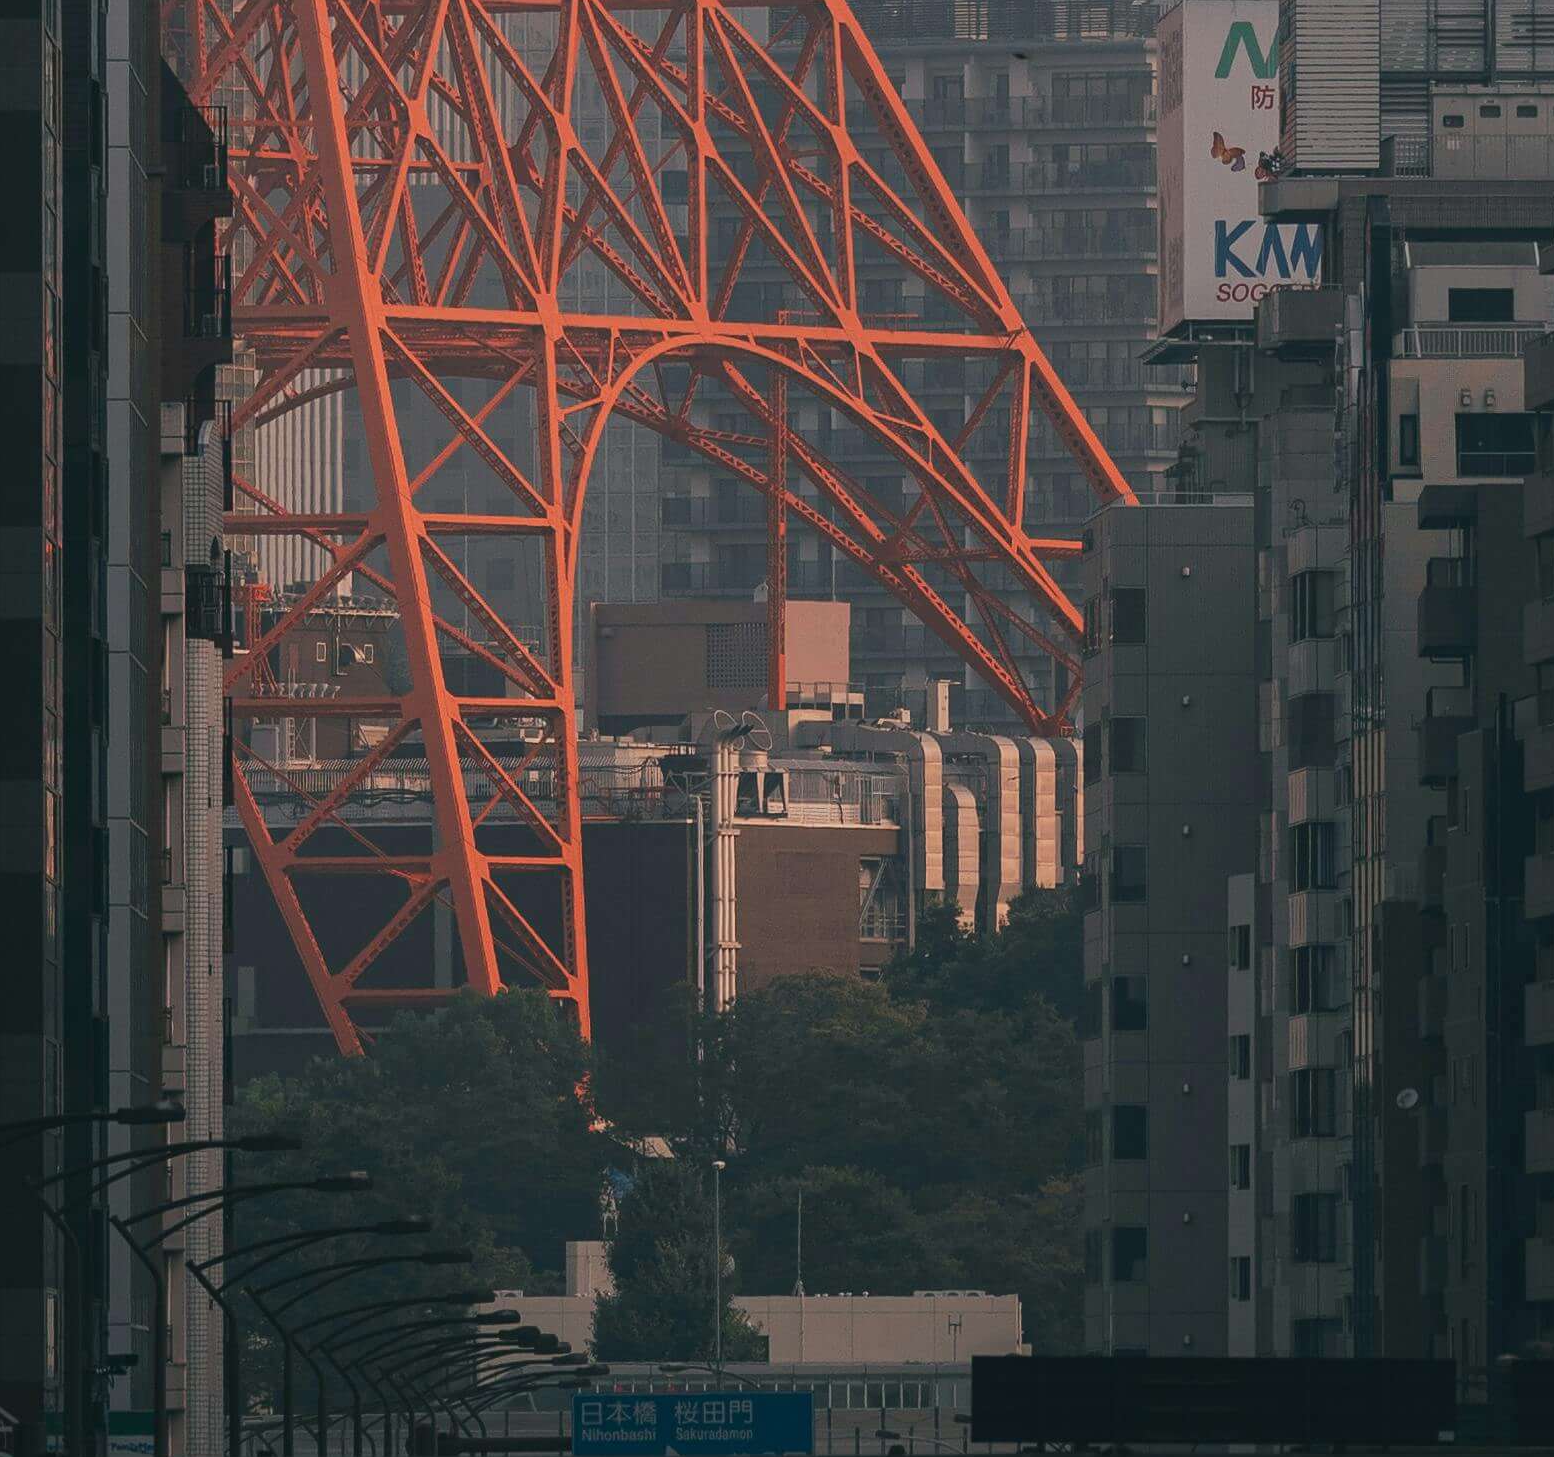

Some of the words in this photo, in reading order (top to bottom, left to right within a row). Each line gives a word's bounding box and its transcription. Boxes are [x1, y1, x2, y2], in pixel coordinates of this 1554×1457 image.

[580, 1401, 657, 1426] 日本橋
[674, 1399, 754, 1425] 桜田門
[581, 1428, 657, 1443] Nihonbashi
[675, 1428, 754, 1442] Sakuradamon
